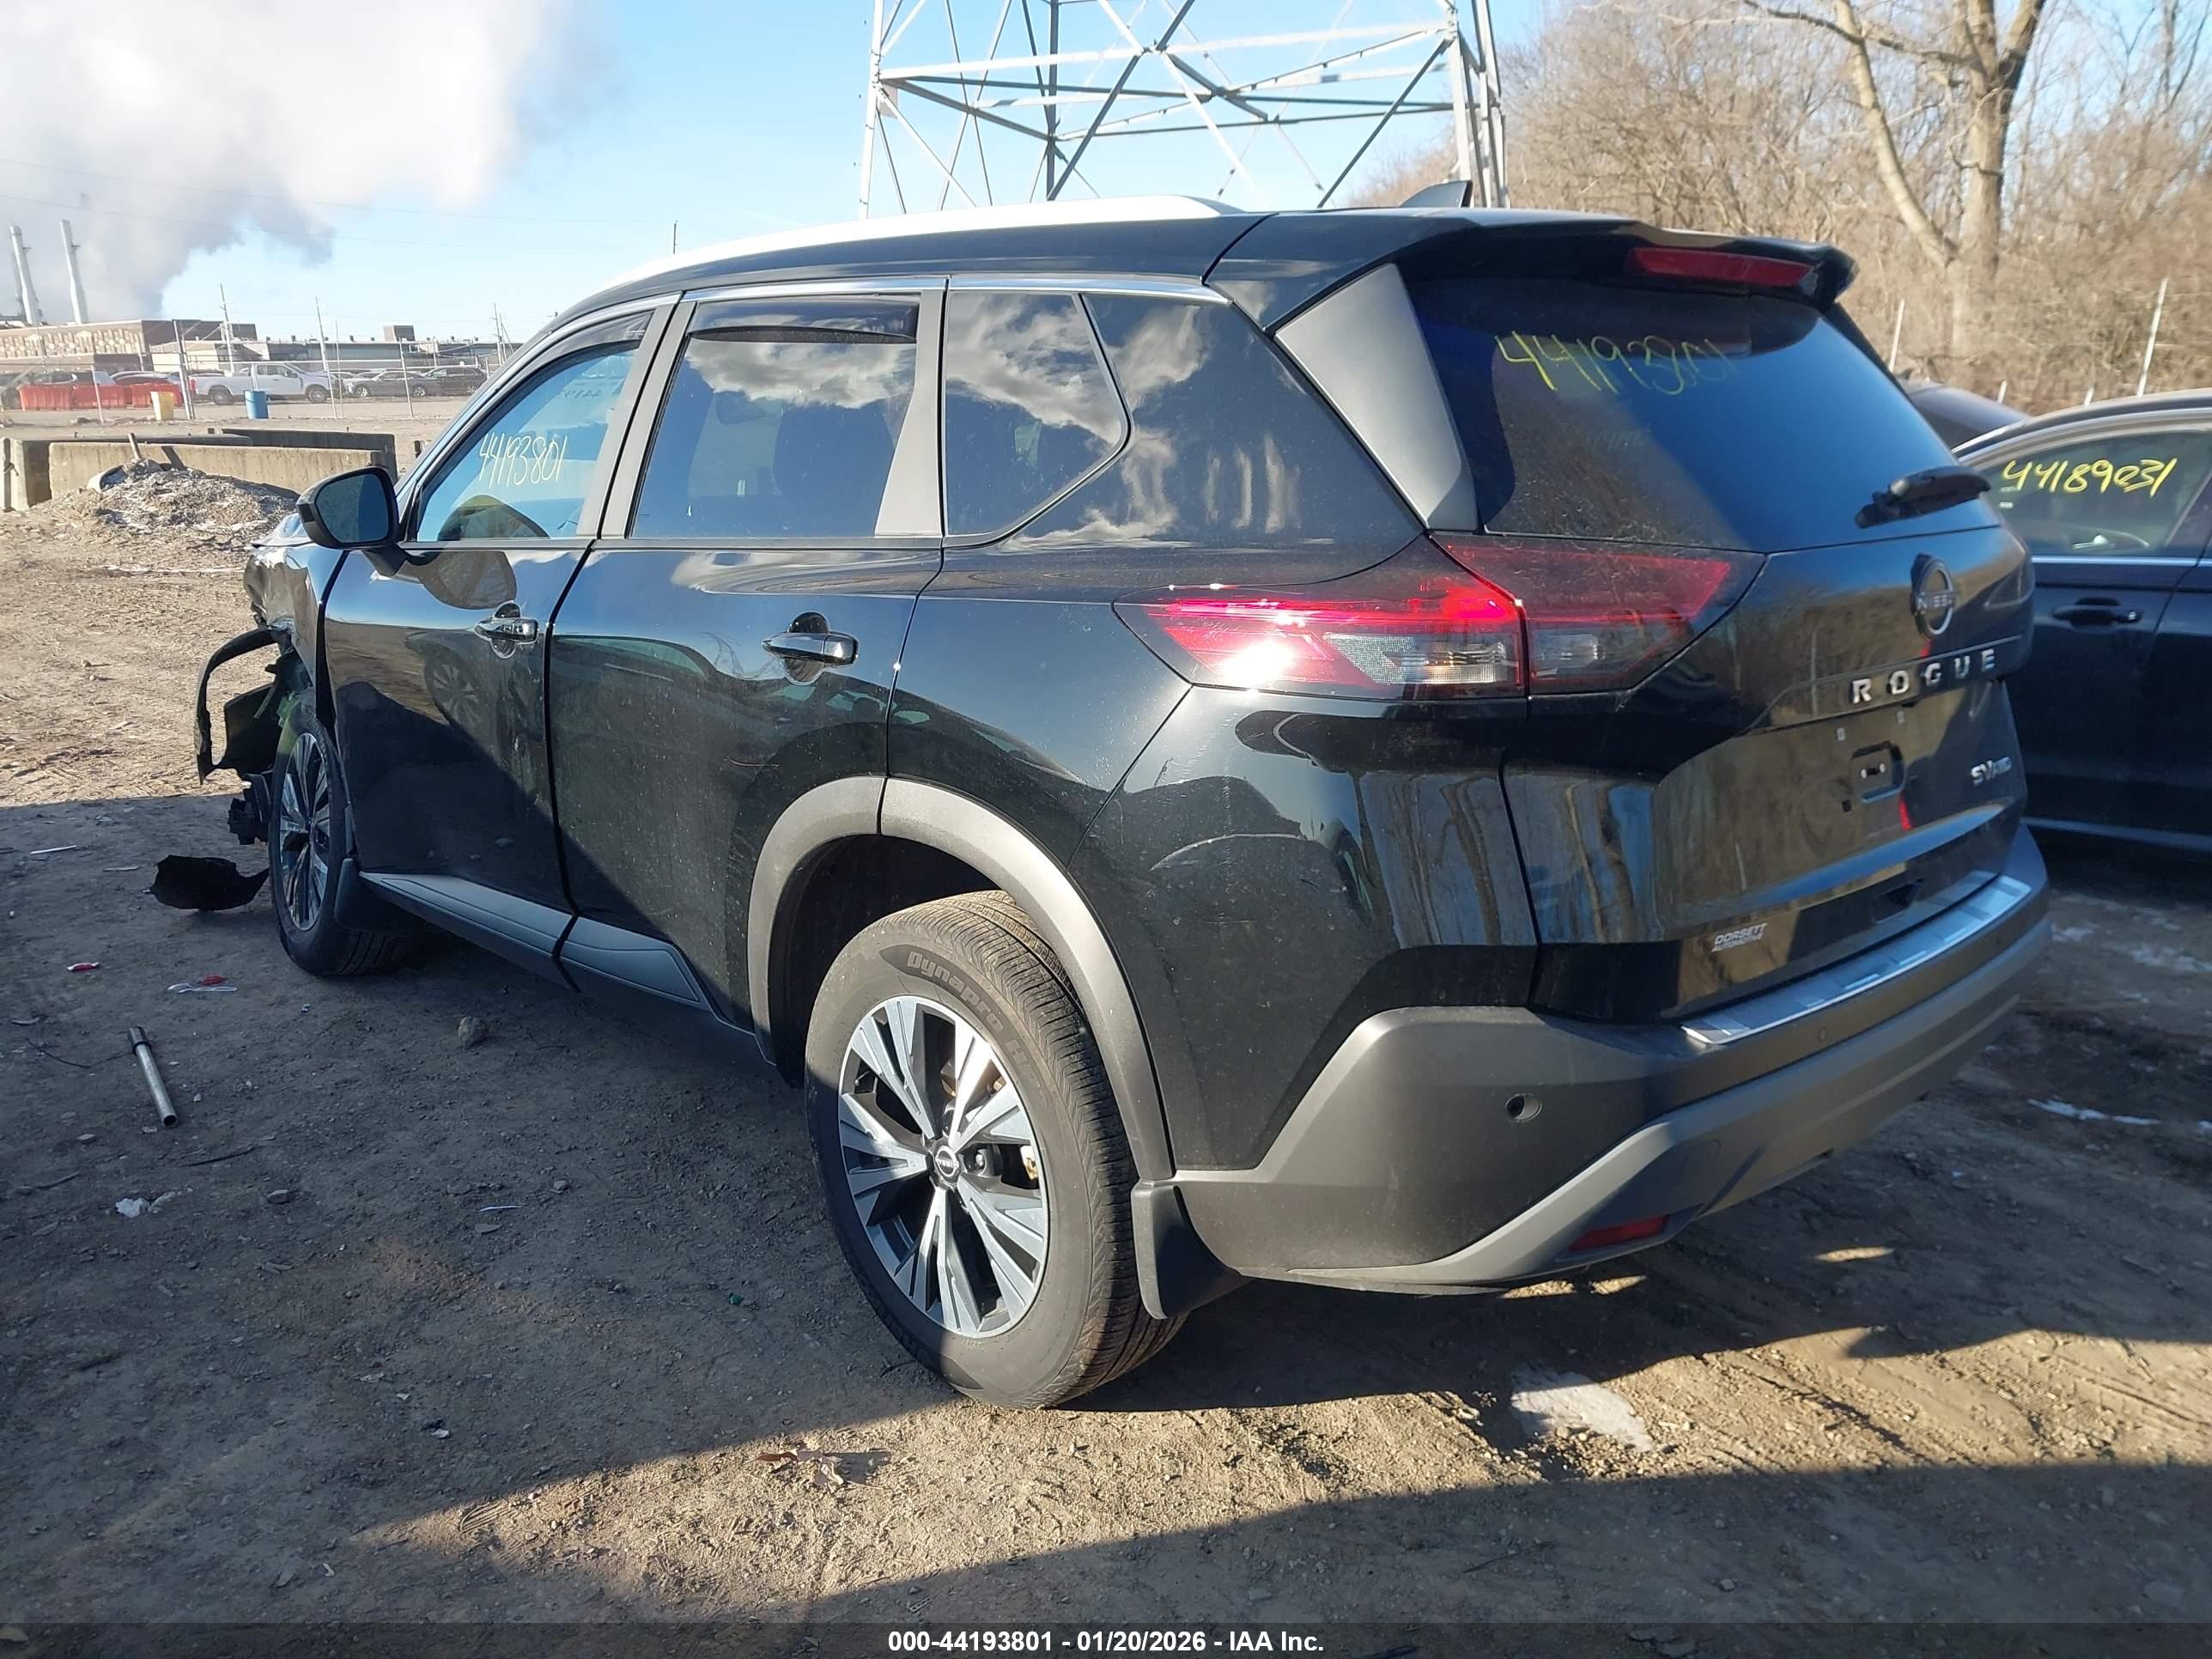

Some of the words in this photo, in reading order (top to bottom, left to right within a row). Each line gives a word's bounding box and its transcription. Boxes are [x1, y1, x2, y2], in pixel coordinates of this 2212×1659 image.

[478, 432, 568, 489] 44193801
[2002, 458, 2178, 498] 44189031
[1915, 592, 1955, 611] NISSA
[1851, 649, 1996, 704] ROGUE
[907, 951, 1006, 1033] Dynapro
